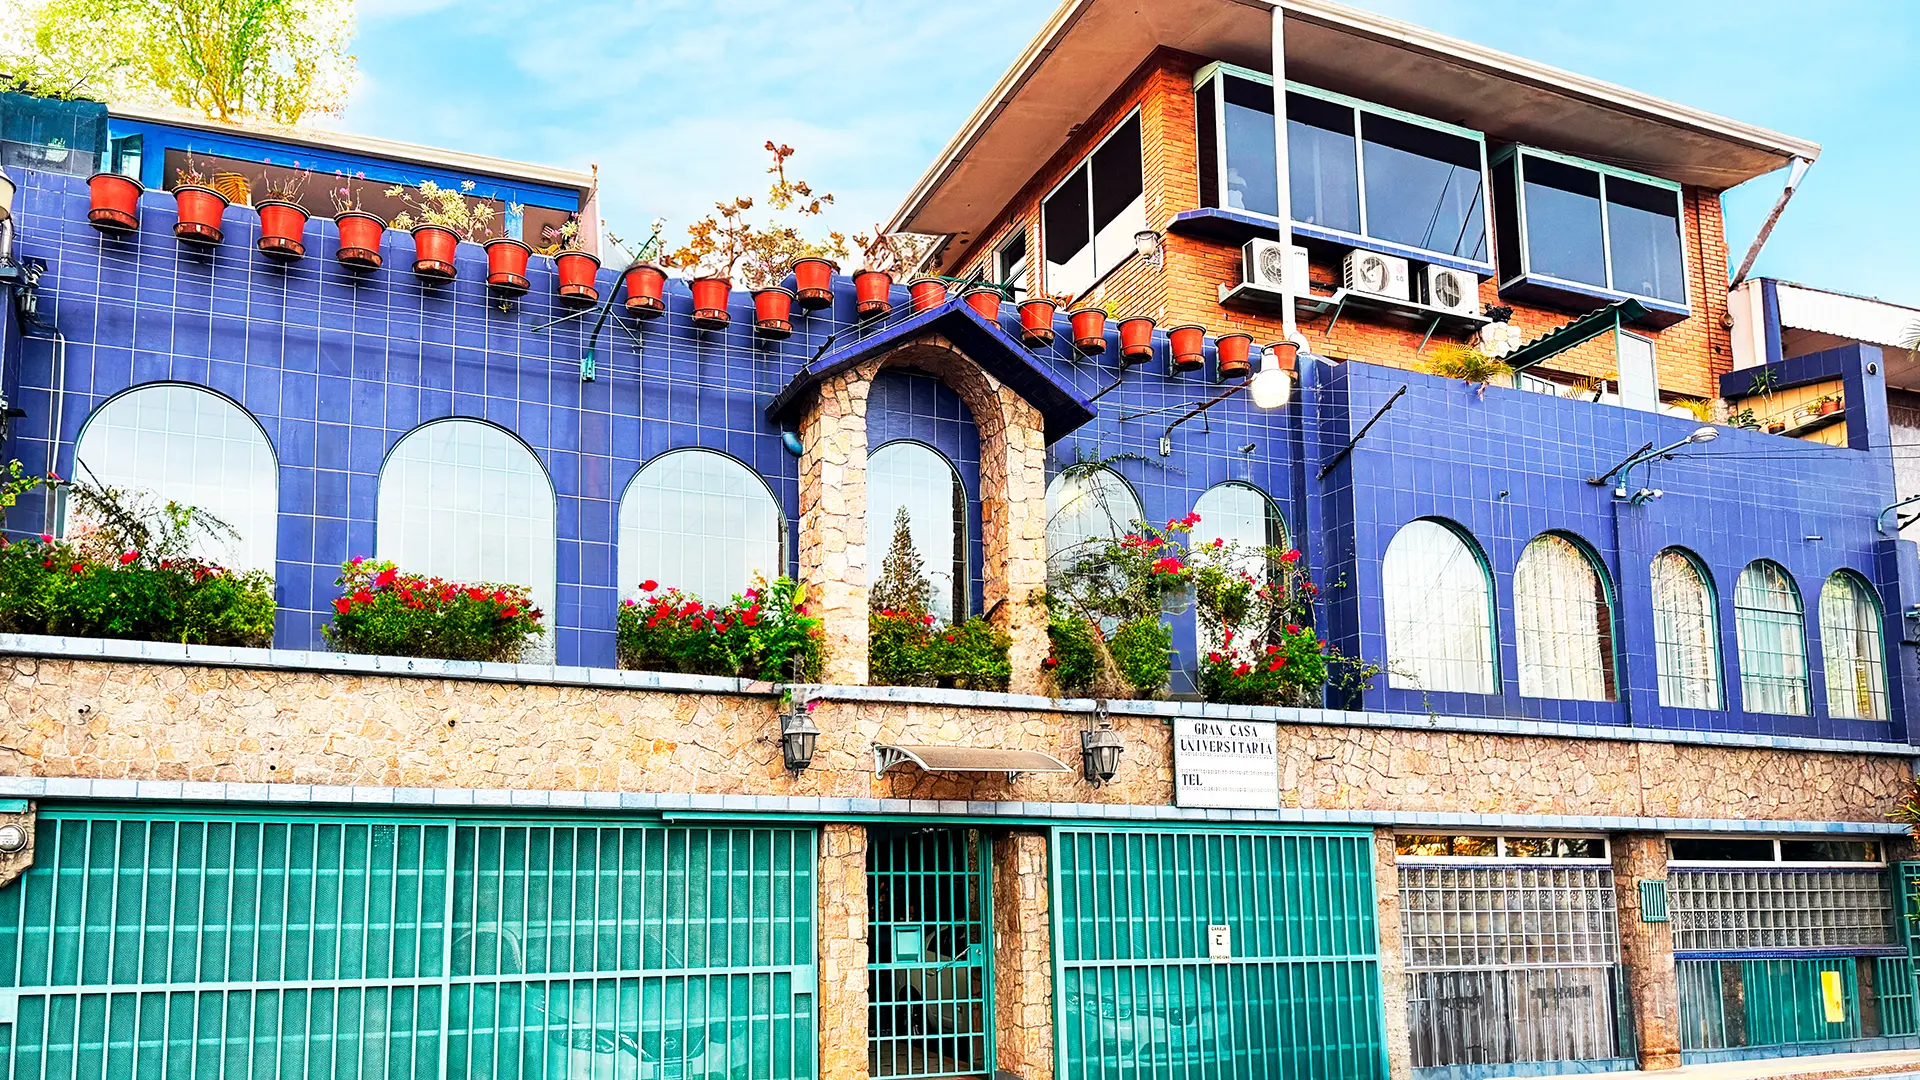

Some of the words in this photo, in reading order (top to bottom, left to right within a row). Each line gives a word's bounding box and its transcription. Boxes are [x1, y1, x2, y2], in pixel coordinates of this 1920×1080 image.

[1194, 722, 1223, 736] GRAN
[1229, 724, 1258, 738] CASA
[1180, 739, 1273, 755] UNIVERSITARIA
[1182, 773, 1203, 786] TEL
